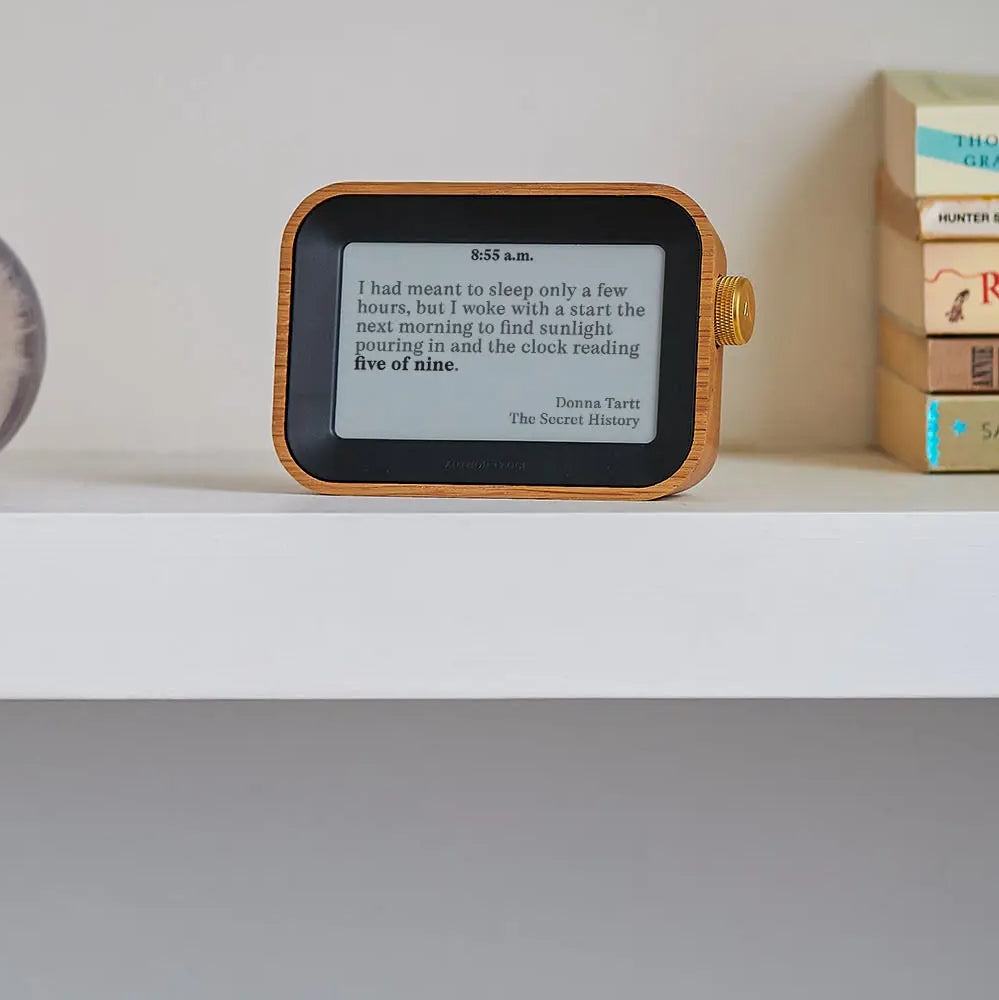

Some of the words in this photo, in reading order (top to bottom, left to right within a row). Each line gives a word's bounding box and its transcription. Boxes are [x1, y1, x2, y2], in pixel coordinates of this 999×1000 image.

[939, 211, 990, 224] HUNTER
[471, 249, 500, 261] 8:55
[504, 251, 534, 261] a.m.
[359, 280, 366, 295] I
[371, 281, 402, 296] had
[407, 282, 462, 296] meant
[467, 283, 484, 297] to
[489, 282, 534, 300] sleep
[539, 282, 577, 301] only
[582, 286, 592, 298] a
[597, 283, 628, 298] few
[358, 299, 411, 316] hours,
[416, 300, 445, 315] but
[450, 300, 457, 315] I
[462, 301, 505, 316] woke
[511, 301, 549, 316] with
[555, 304, 564, 316] a
[570, 303, 612, 317] start
[617, 302, 646, 317] the
[356, 320, 393, 333] next
[399, 320, 473, 338] morning
[478, 321, 495, 334] to
[500, 320, 534, 335] find
[539, 321, 613, 339] sunlight
[354, 338, 424, 356] pouring
[427, 339, 445, 353] in
[450, 339, 482, 353] and
[488, 338, 516, 354] the
[521, 339, 567, 354] clock
[573, 340, 640, 359] reading
[354, 356, 386, 371] five
[391, 356, 411, 371] of
[414, 357, 459, 372] nine.
[555, 396, 601, 409] Donna
[605, 397, 640, 409] Tartt
[509, 412, 536, 425] The
[540, 412, 584, 426] Secret
[588, 413, 640, 429] History
